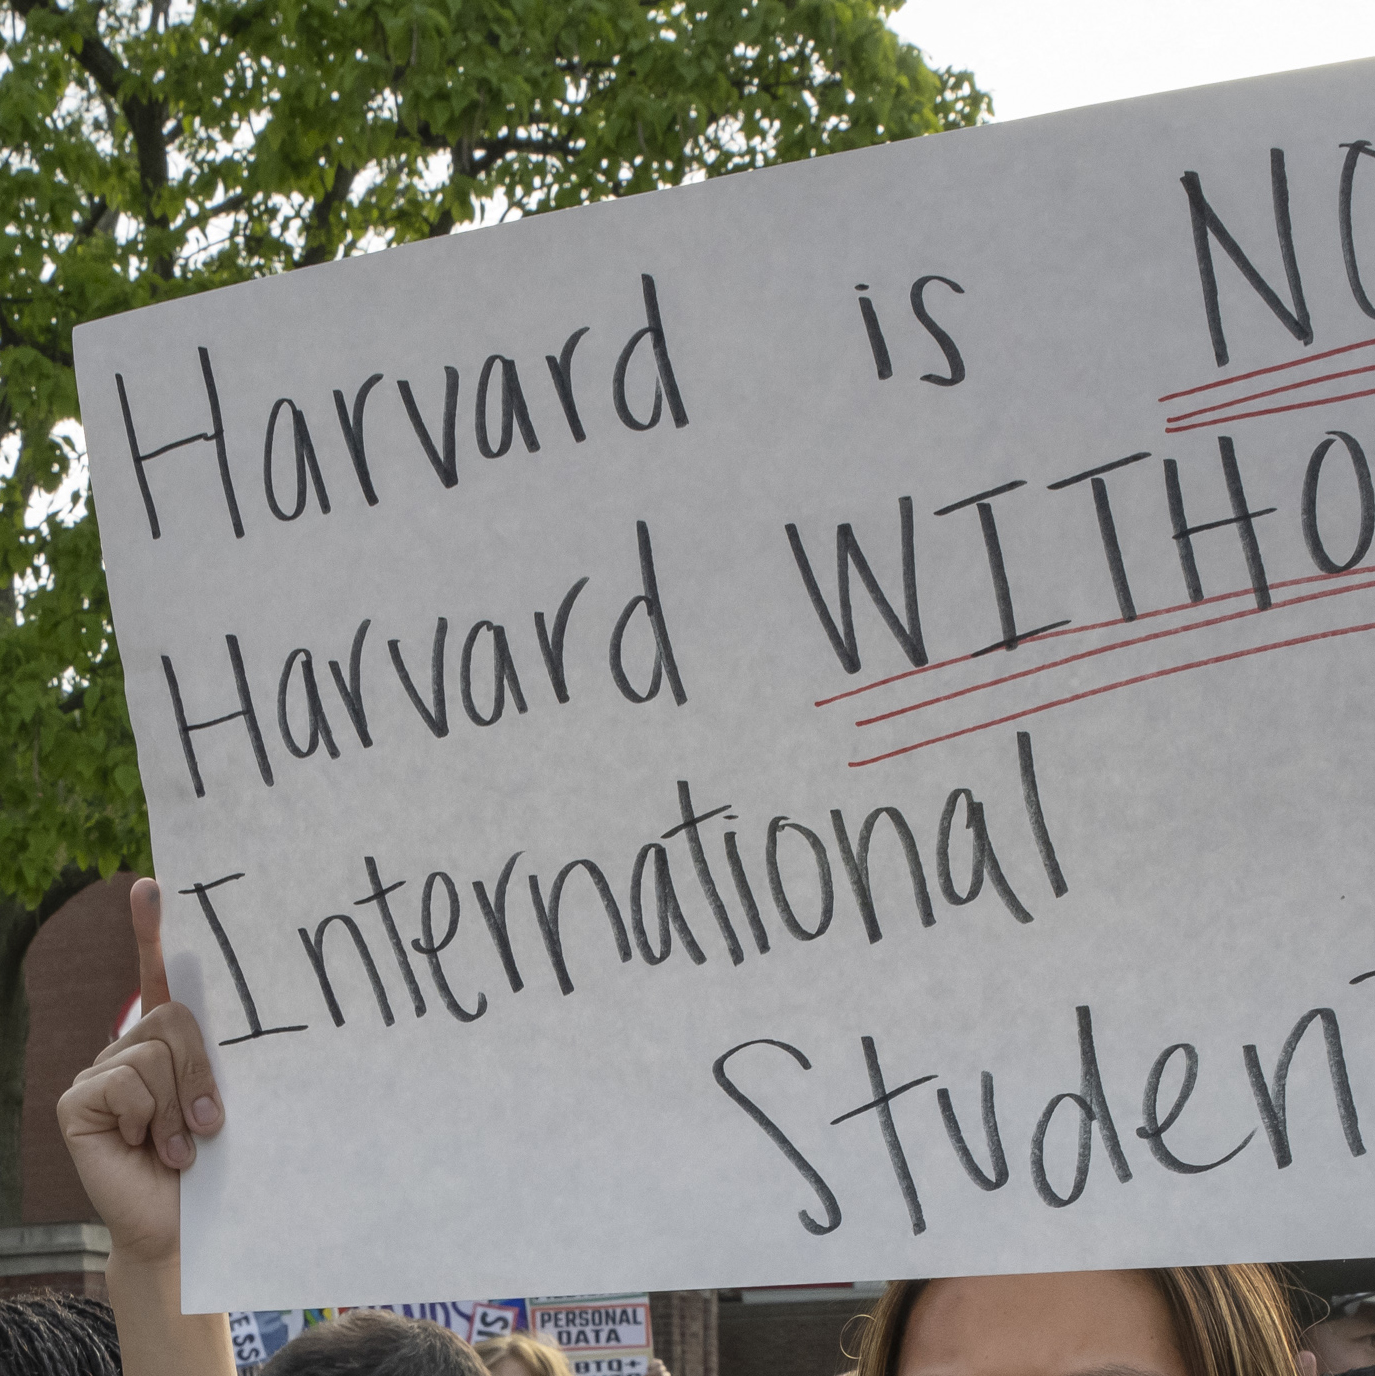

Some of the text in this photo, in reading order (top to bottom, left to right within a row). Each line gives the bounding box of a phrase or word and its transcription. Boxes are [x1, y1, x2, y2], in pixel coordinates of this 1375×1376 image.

[114, 273, 690, 540] Harvard
[854, 275, 967, 387] is
[160, 519, 688, 799] Harvard
[177, 731, 1070, 1048] International
[229, 1314, 260, 1361] ESS
[540, 1309, 642, 1328] PERSONAL
[558, 1328, 622, 1346] DATA
[574, 1359, 642, 1374] BTQ+
